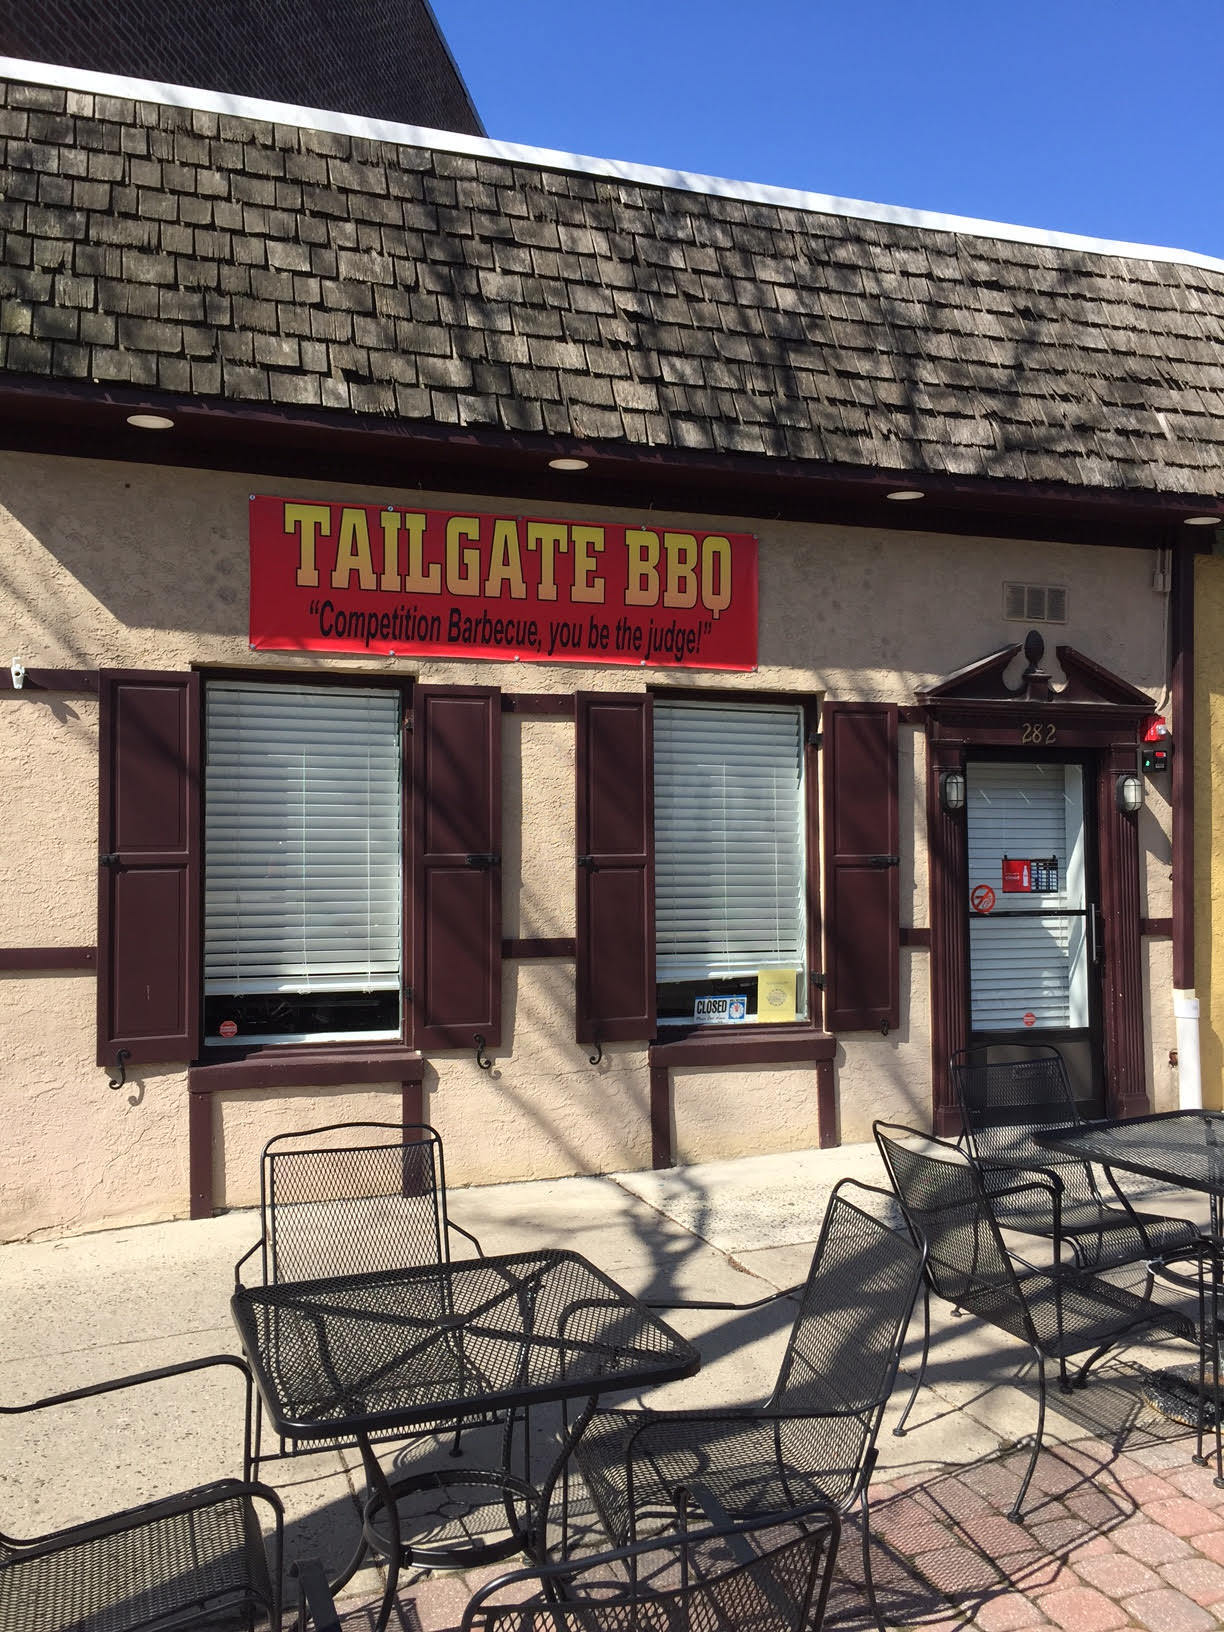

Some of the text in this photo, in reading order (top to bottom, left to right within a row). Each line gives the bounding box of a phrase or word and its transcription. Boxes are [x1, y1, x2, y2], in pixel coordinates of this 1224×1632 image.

[283, 502, 732, 620] TAILGATE BBQ
[448, 608, 542, 652] Barbecue,
[548, 621, 583, 656] you
[588, 615, 609, 649] be
[615, 617, 643, 651] the
[1022, 722, 1056, 744] 282
[696, 1000, 727, 1014] CLOSED
